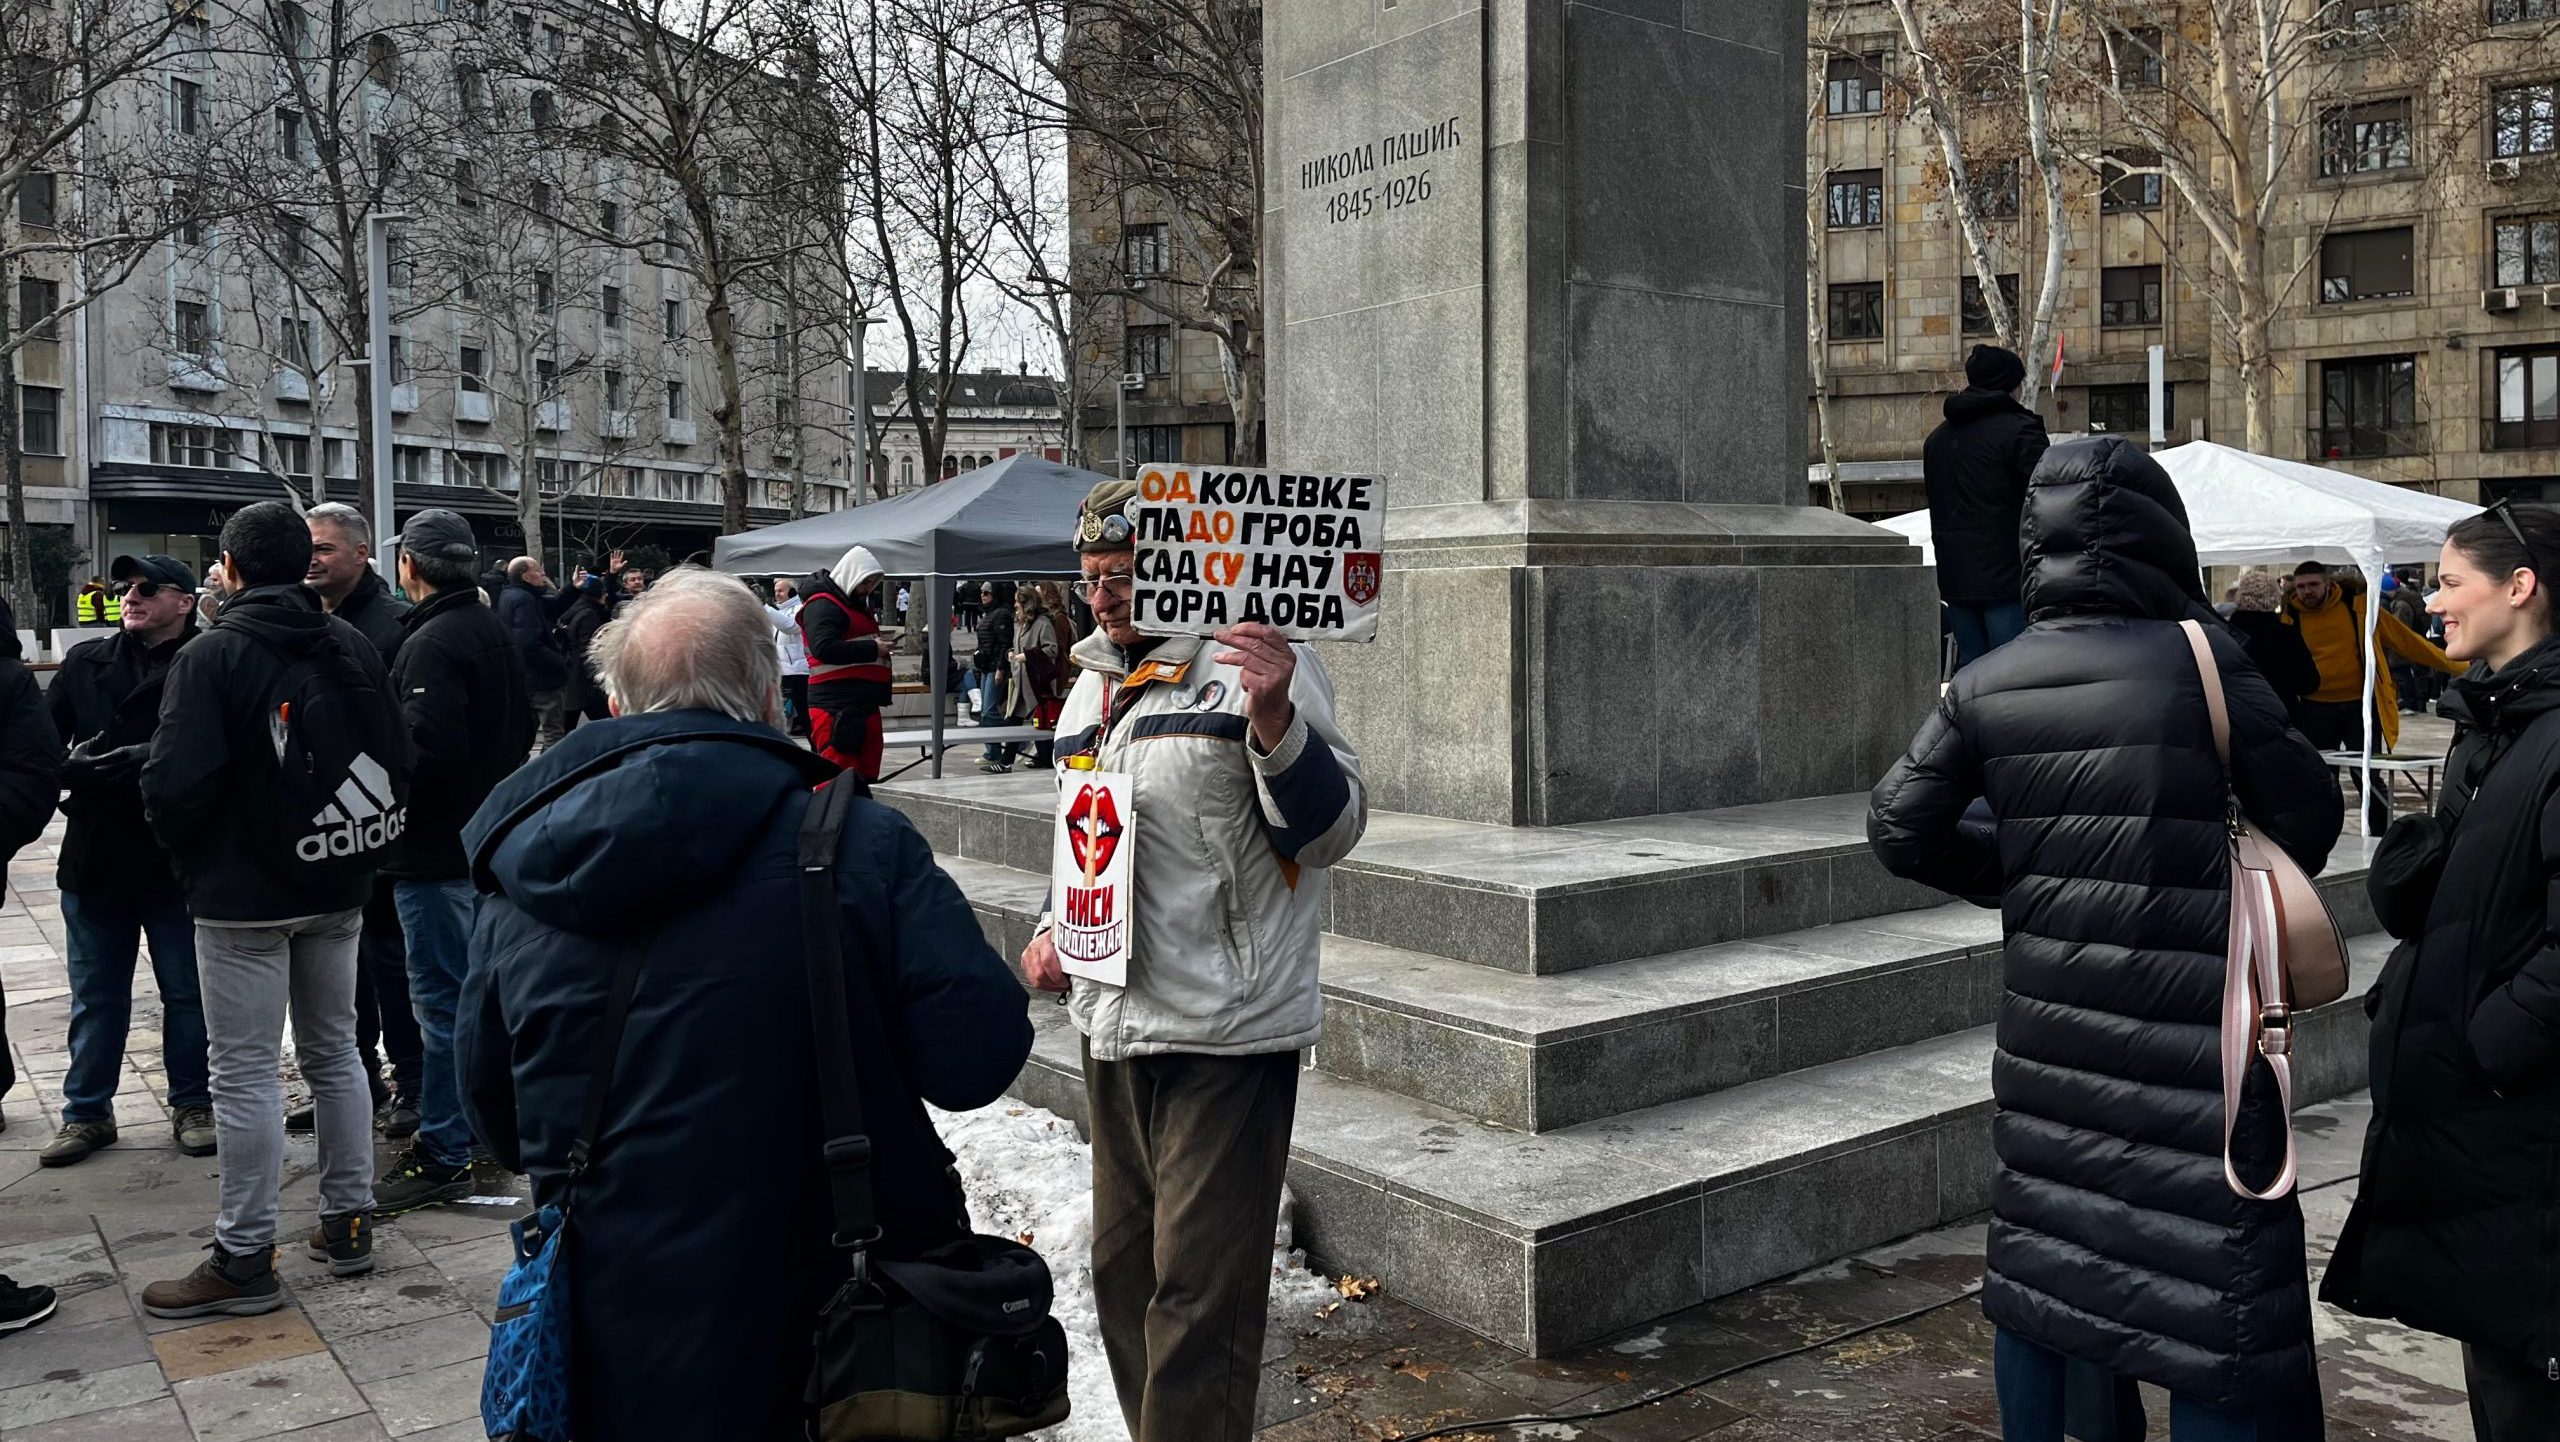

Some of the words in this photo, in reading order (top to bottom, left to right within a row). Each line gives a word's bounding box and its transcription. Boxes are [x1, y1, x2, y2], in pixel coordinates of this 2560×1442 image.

[1302, 143, 1374, 190] НИКОЛА
[1383, 116, 1460, 167] ПАШИЋ
[1326, 169, 1431, 224] 1845-1926
[1141, 471, 1197, 504] ОД
[1199, 470, 1373, 511] КОЛЕВКЕ
[1137, 507, 1185, 543] ПА
[1185, 510, 1235, 544] ДО
[1240, 511, 1362, 550] ГРОБА
[1134, 548, 1200, 585] САД
[1203, 551, 1245, 588] СУ
[1133, 589, 1228, 625] ГОРА
[1238, 591, 1345, 629] ДОБА
[1066, 884, 1114, 928] НИСИ
[1058, 920, 1122, 962] НАДЛЕЖАН
